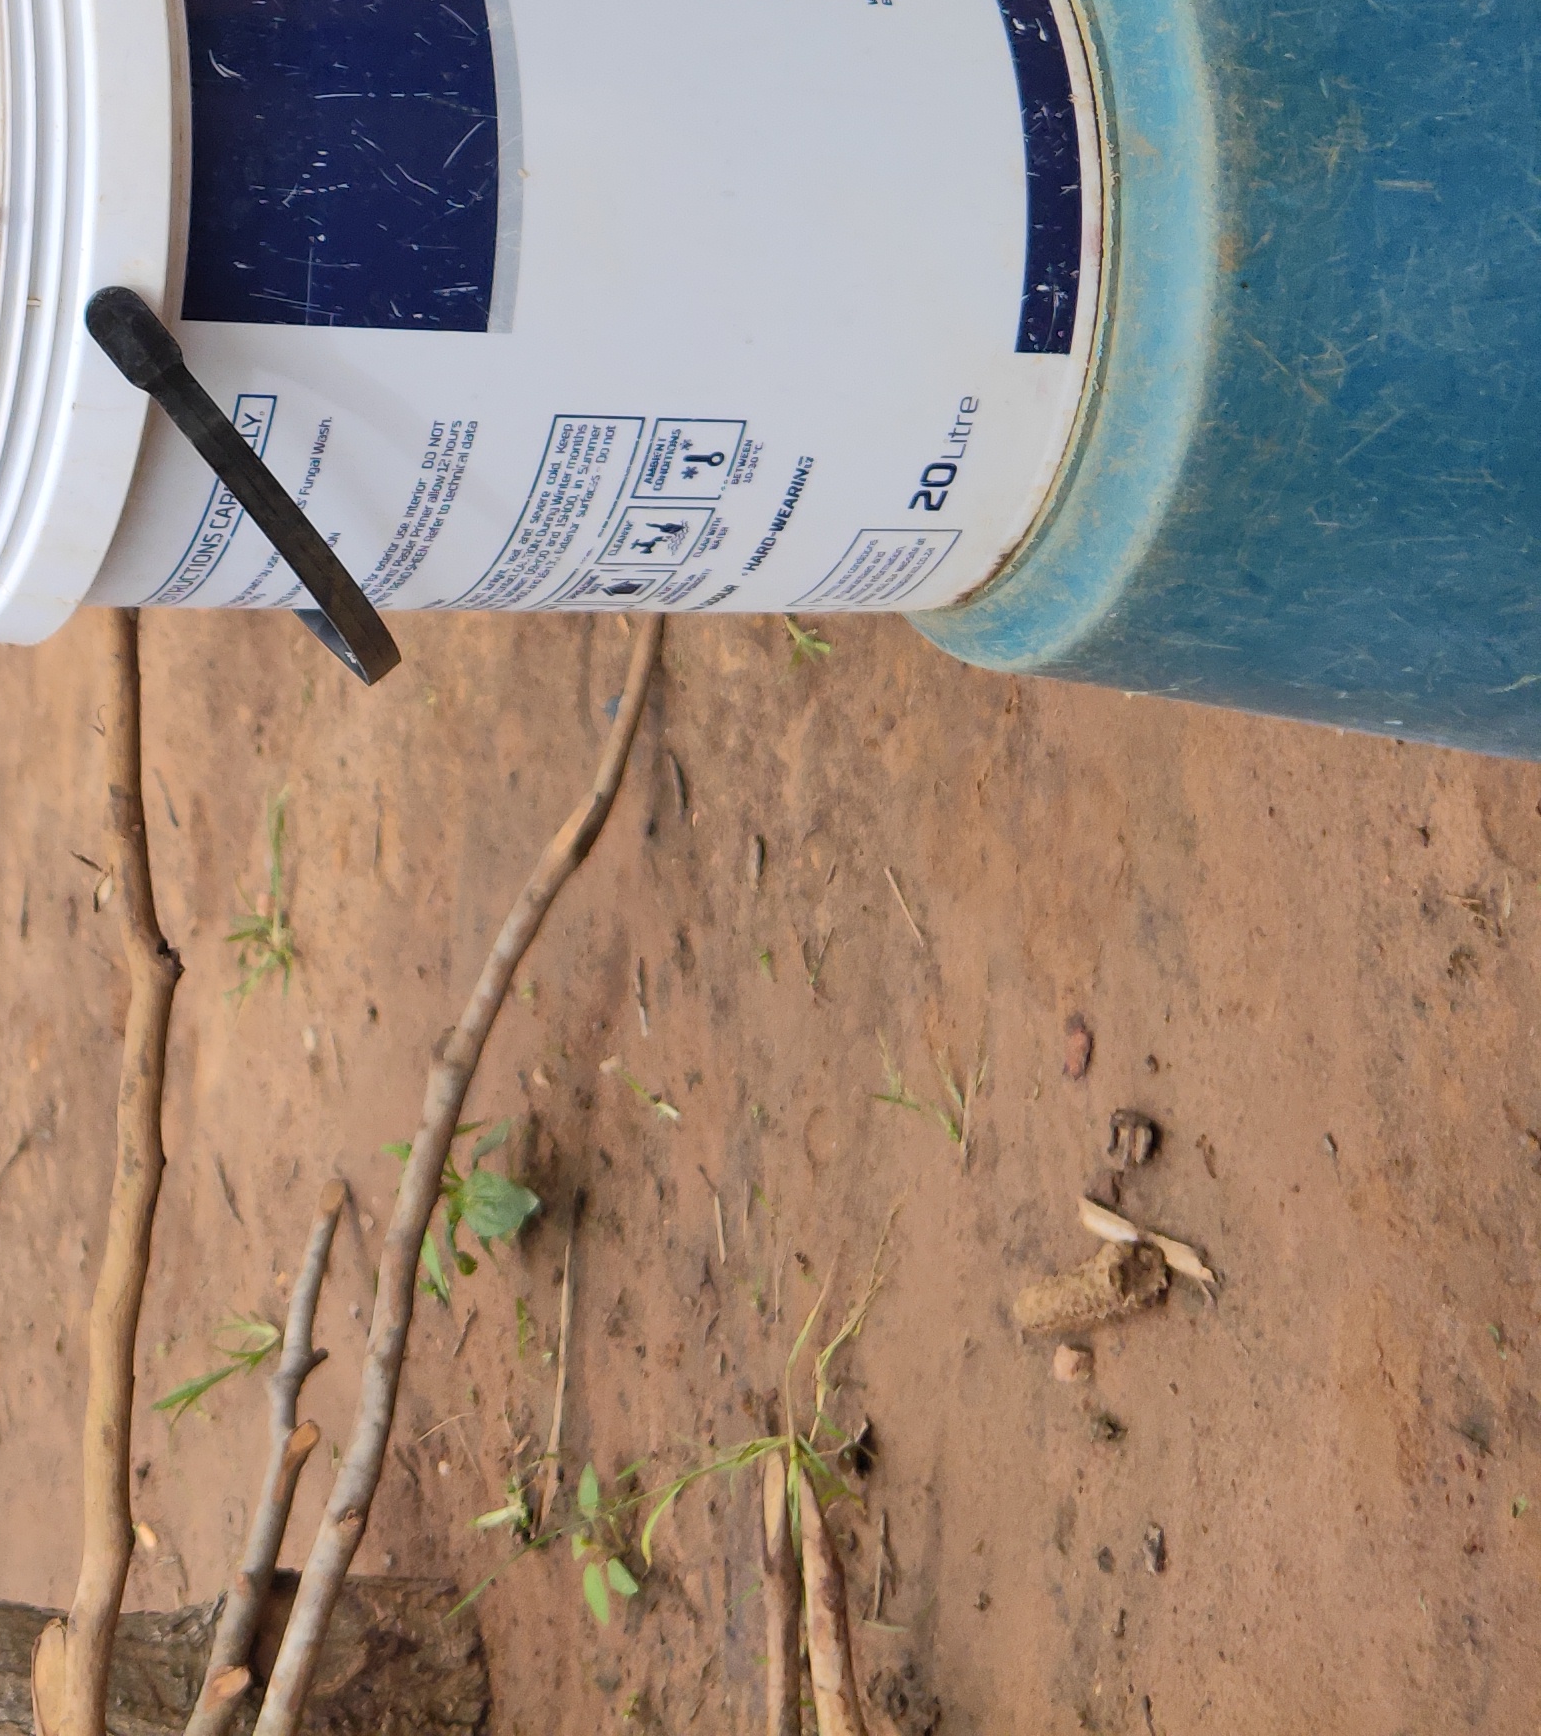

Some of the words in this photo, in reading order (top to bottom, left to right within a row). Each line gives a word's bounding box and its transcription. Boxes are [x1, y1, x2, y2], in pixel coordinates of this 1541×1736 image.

[427, 420, 445, 446] NOT
[457, 421, 478, 449] data
[602, 425, 616, 444] not
[298, 457, 321, 495] Fungal
[311, 416, 332, 454] Wash.
[421, 451, 437, 469] DO
[596, 447, 610, 464] Do
[643, 437, 666, 484] AMBIENT
[653, 429, 681, 491] CONDITIONS
[730, 439, 753, 485] BETWEEN
[907, 462, 958, 512] 20
[939, 396, 980, 459] Litre
[442, 452, 469, 502] technical
[518, 529, 534, 544] and
[528, 491, 550, 524] severe
[544, 461, 562, 485] cold.
[554, 424, 573, 454] Keep
[535, 508, 559, 536] During
[549, 471, 572, 506] Winter
[565, 424, 588, 469] months
[743, 456, 759, 484] 10-30
[392, 540, 416, 566] Plaster
[409, 505, 434, 537] Primer
[426, 475, 446, 503] allow
[442, 420, 462, 456] hours
[546, 532, 561, 547] and
[570, 480, 585, 489] in
[579, 424, 601, 475] Summer
[435, 504, 451, 515] to
[393, 521, 411, 539] use.
[423, 518, 444, 542] Refer
[705, 517, 723, 536] WITH
[374, 542, 399, 571] exterior
[847, 539, 878, 574] conditions
[871, 551, 886, 564] and
[386, 572, 412, 591] TREND
